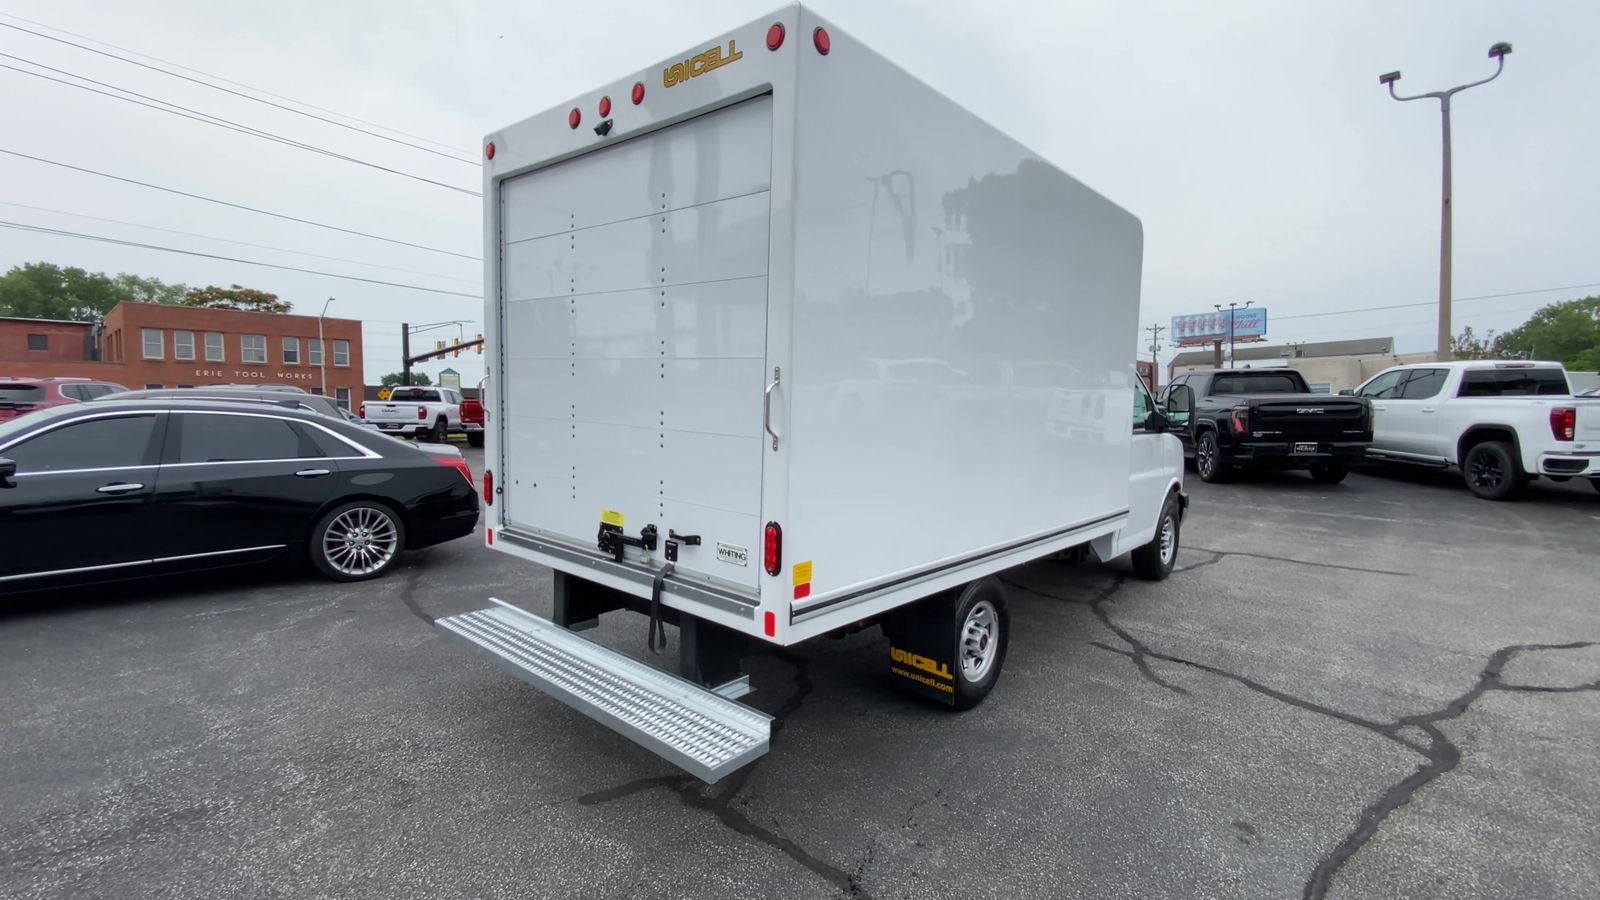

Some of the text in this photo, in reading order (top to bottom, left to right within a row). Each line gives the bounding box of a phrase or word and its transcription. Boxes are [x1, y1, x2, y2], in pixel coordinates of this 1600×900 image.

[663, 39, 744, 88] UNICELL
[195, 369, 314, 380] ERIE TOOL WORKS
[719, 548, 747, 561] WHITING
[890, 645, 953, 681] UNICELL
[891, 666, 953, 693] www.unicell.com
